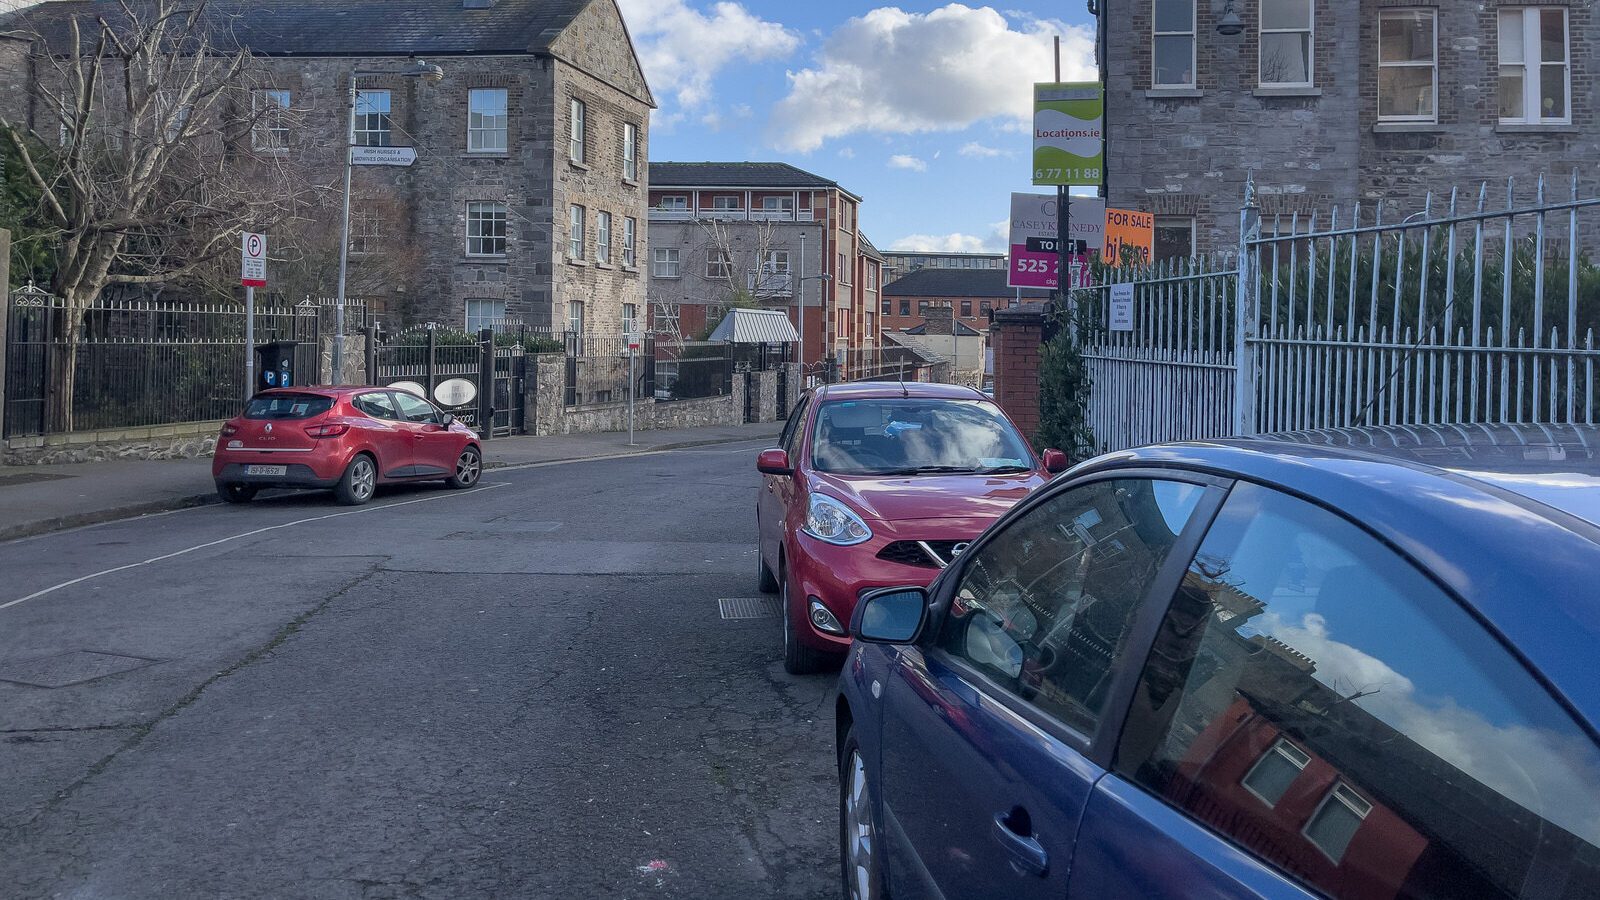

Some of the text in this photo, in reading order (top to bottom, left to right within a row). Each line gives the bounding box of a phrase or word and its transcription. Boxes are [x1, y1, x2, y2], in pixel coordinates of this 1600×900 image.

[1036, 128, 1100, 138] Locations.ie
[1035, 168, 1100, 179] 6 77 11 88
[1107, 211, 1152, 229] FOR SALE
[1039, 241, 1054, 250] TO
[1017, 259, 1048, 273] 525
